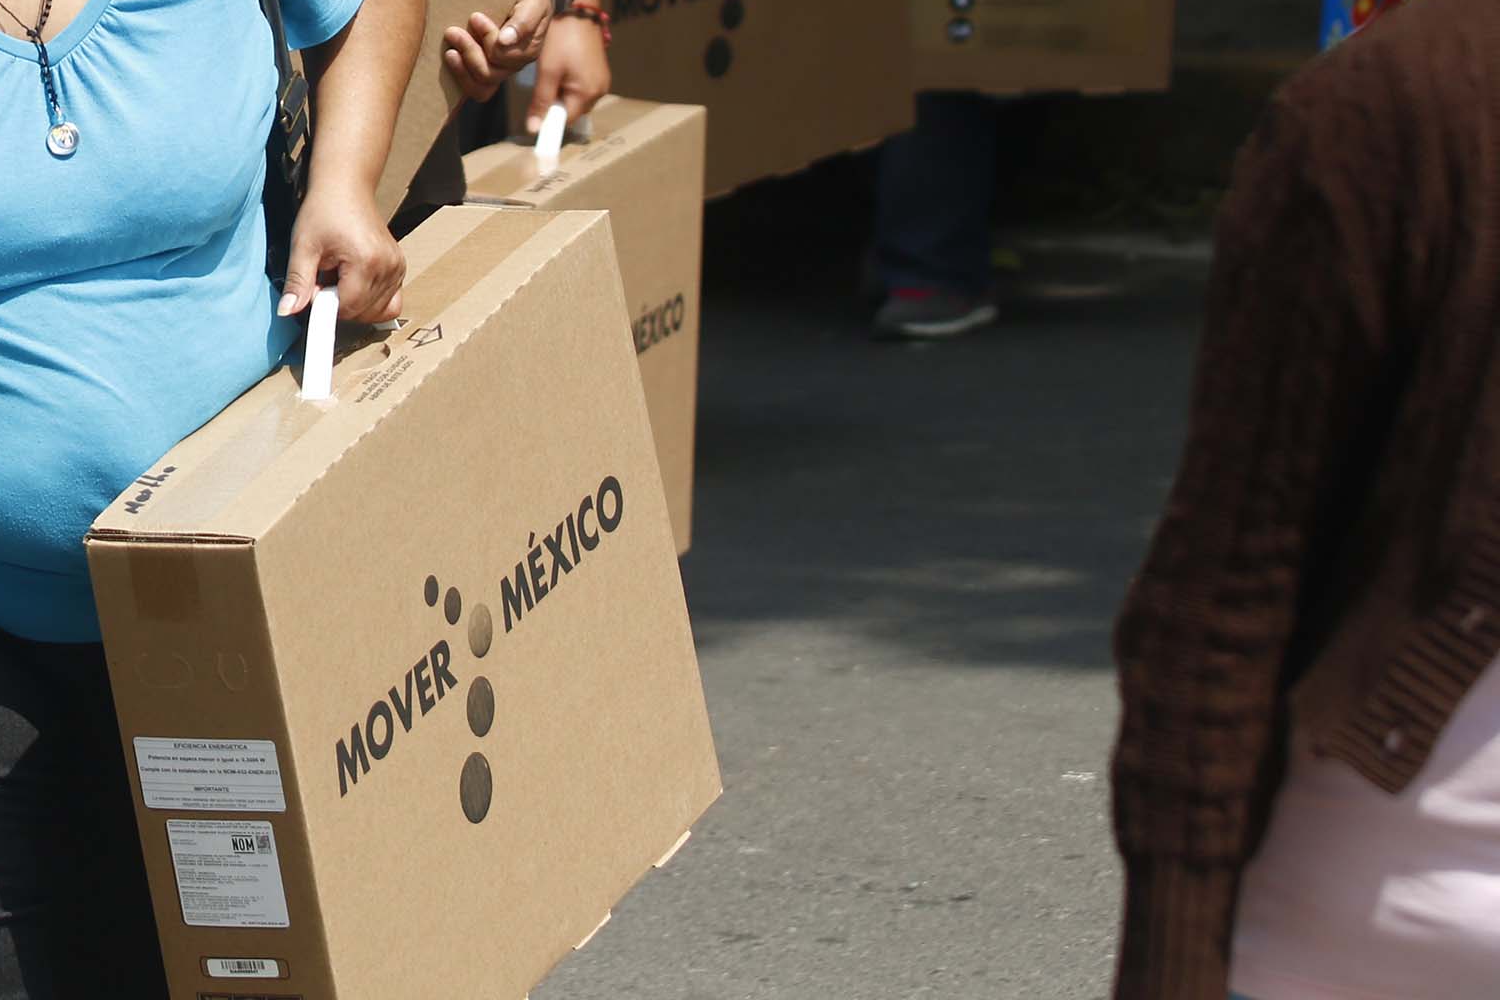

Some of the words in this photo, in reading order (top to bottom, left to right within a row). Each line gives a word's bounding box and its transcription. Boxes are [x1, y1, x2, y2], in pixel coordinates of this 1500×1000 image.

[335, 638, 458, 799] MOVER
[500, 475, 623, 634] MÉXICO
[231, 837, 255, 851] NOM
